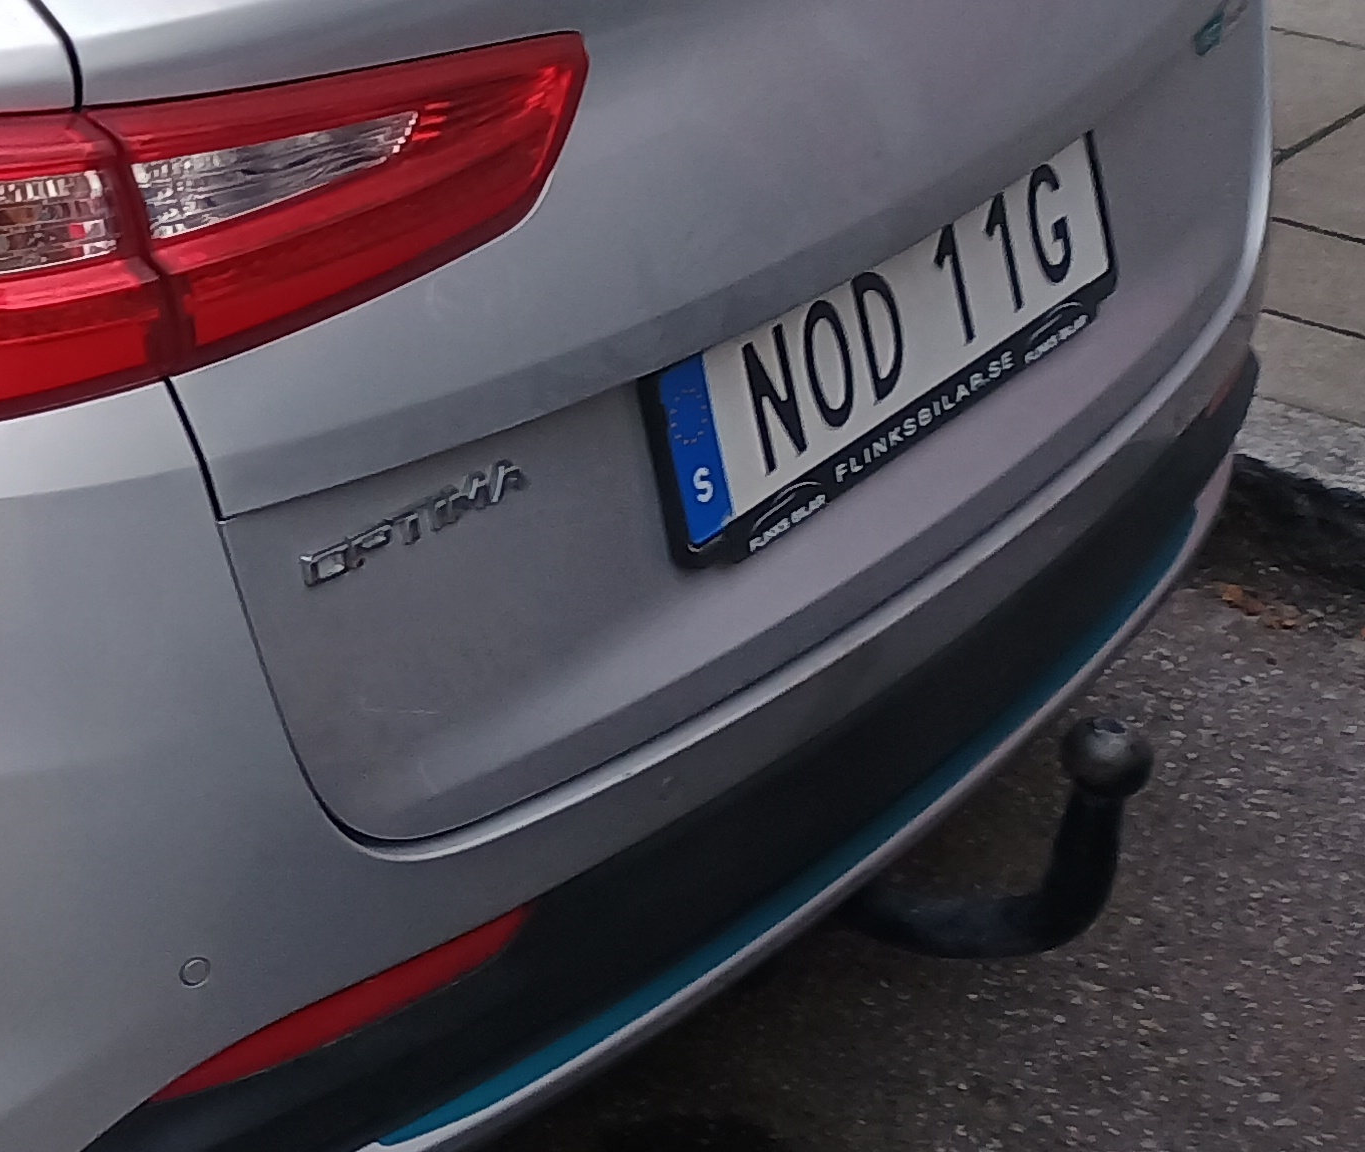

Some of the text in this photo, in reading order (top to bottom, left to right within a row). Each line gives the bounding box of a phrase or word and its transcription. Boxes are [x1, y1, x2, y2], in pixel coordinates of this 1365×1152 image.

[741, 164, 1073, 476] NOD 11G
[834, 350, 1016, 483] FLINKSBILAR.SE
[692, 467, 715, 503] S
